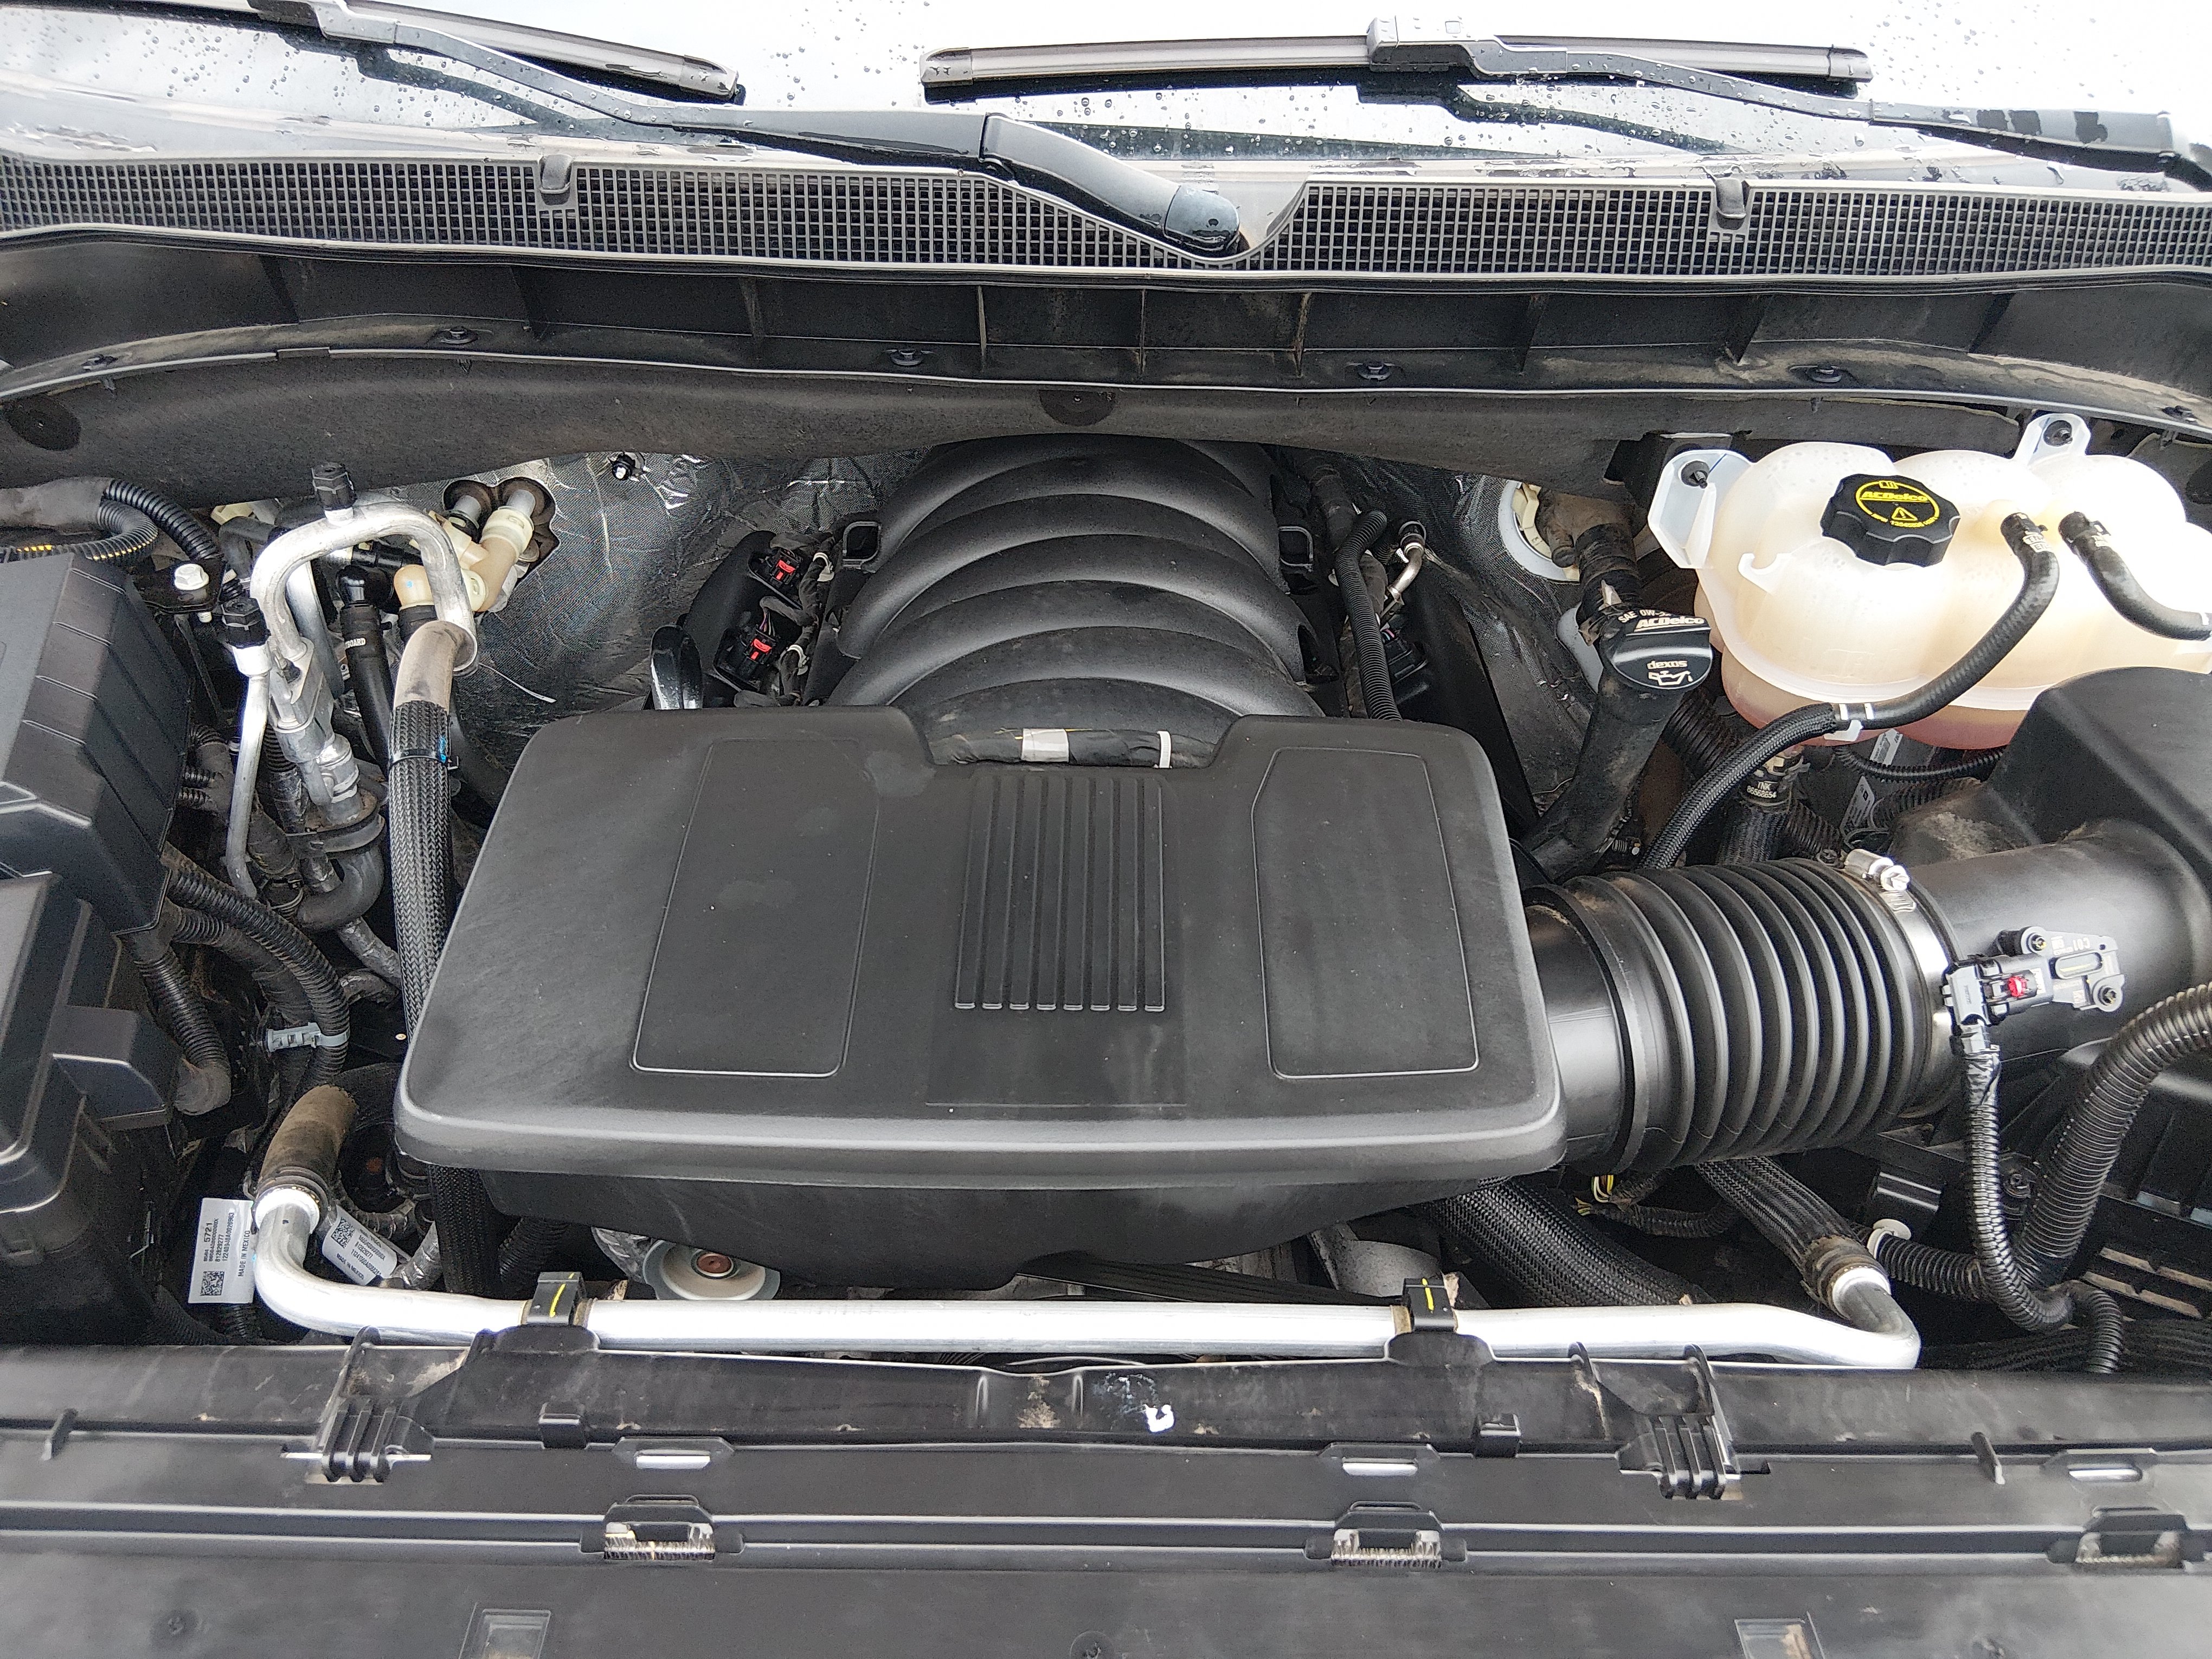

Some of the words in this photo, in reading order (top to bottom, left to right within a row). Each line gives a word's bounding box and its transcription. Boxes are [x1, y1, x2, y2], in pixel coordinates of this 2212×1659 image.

[1862, 491, 1928, 501] ACDelco
[1618, 610, 1638, 623] SAE
[1635, 616, 1705, 629] ACDelco
[1647, 660, 1688, 670] dexos
[203, 1223, 213, 1243] 5721
[238, 1261, 246, 1277] MADE
[242, 1230, 250, 1252] MEXICO
